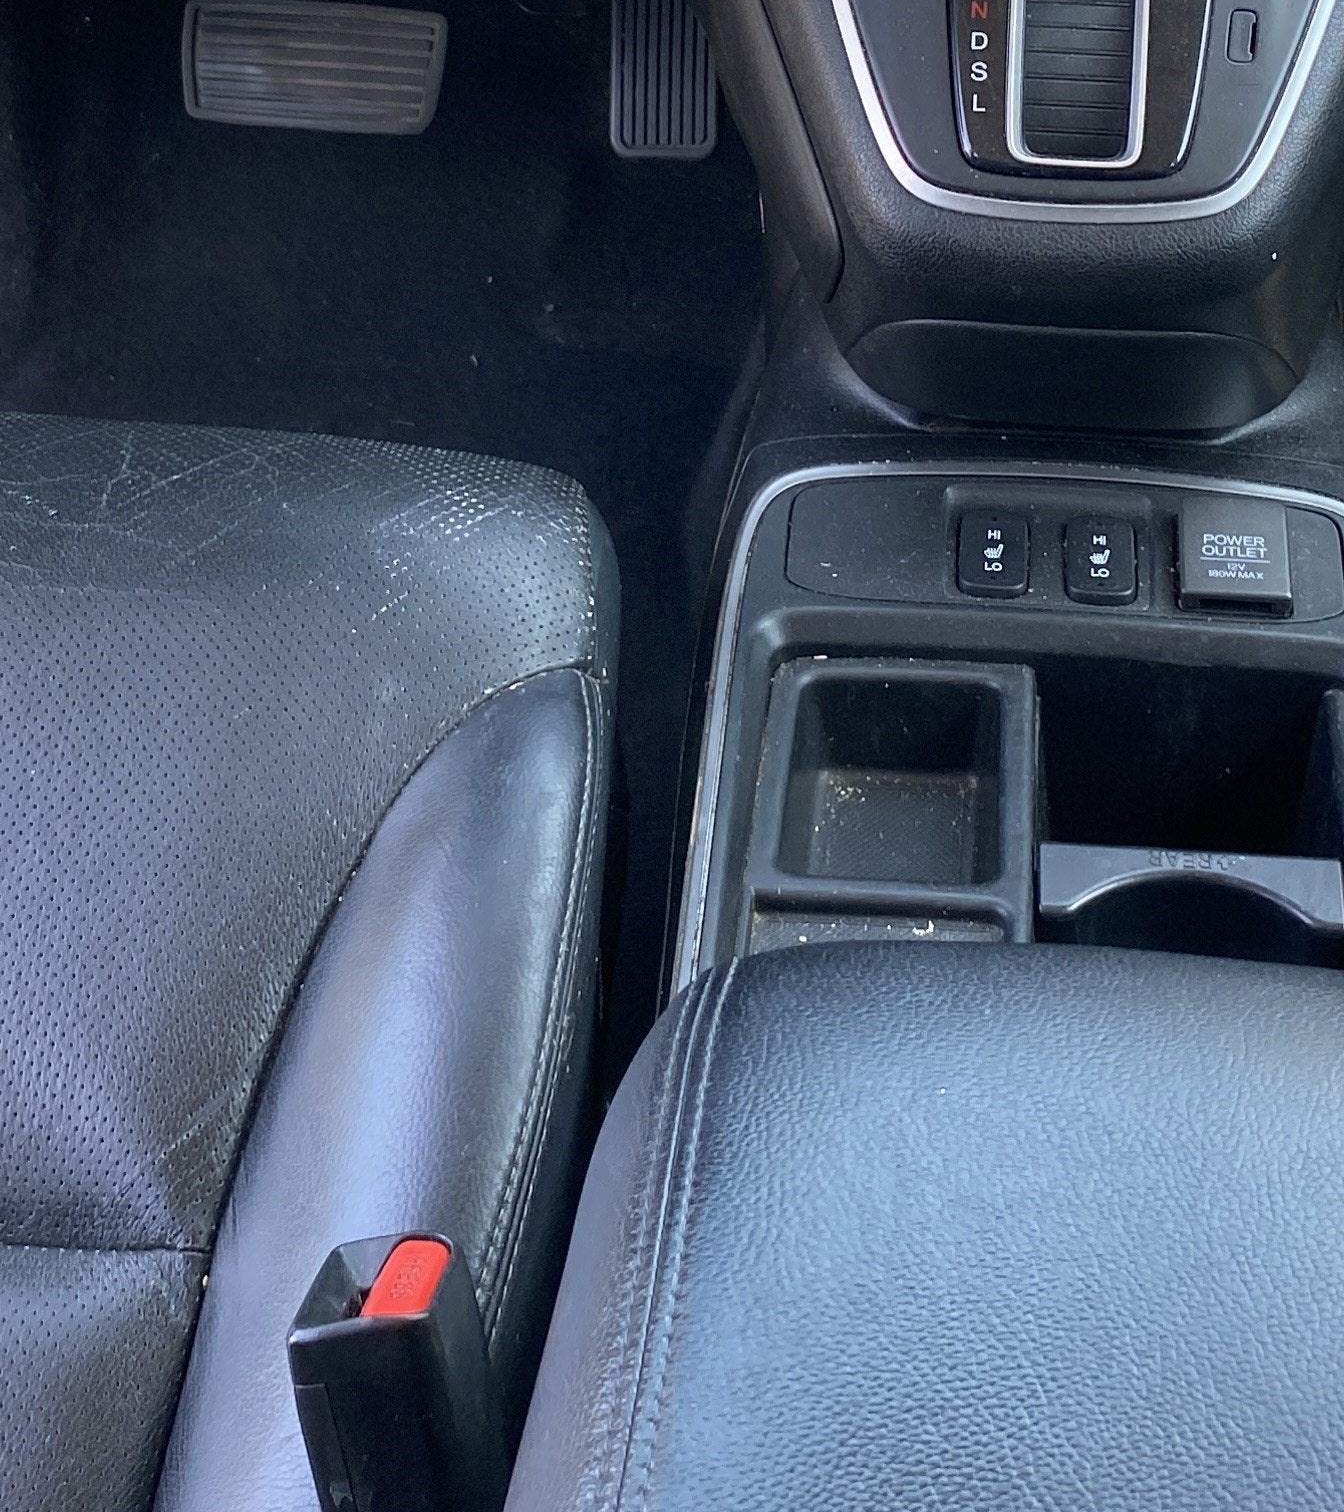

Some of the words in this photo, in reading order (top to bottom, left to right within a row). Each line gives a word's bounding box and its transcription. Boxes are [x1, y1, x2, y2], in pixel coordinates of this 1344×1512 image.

[971, 1, 988, 18] N
[971, 32, 988, 50] D
[970, 61, 988, 81] S
[972, 94, 986, 112] L
[987, 529, 1001, 540] HI
[1093, 535, 1106, 546] HI
[1202, 533, 1265, 547] POWER
[1201, 545, 1268, 559] OUTLET
[984, 561, 1003, 572] LO
[1090, 567, 1110, 578] LO
[1227, 563, 1246, 571] 12V
